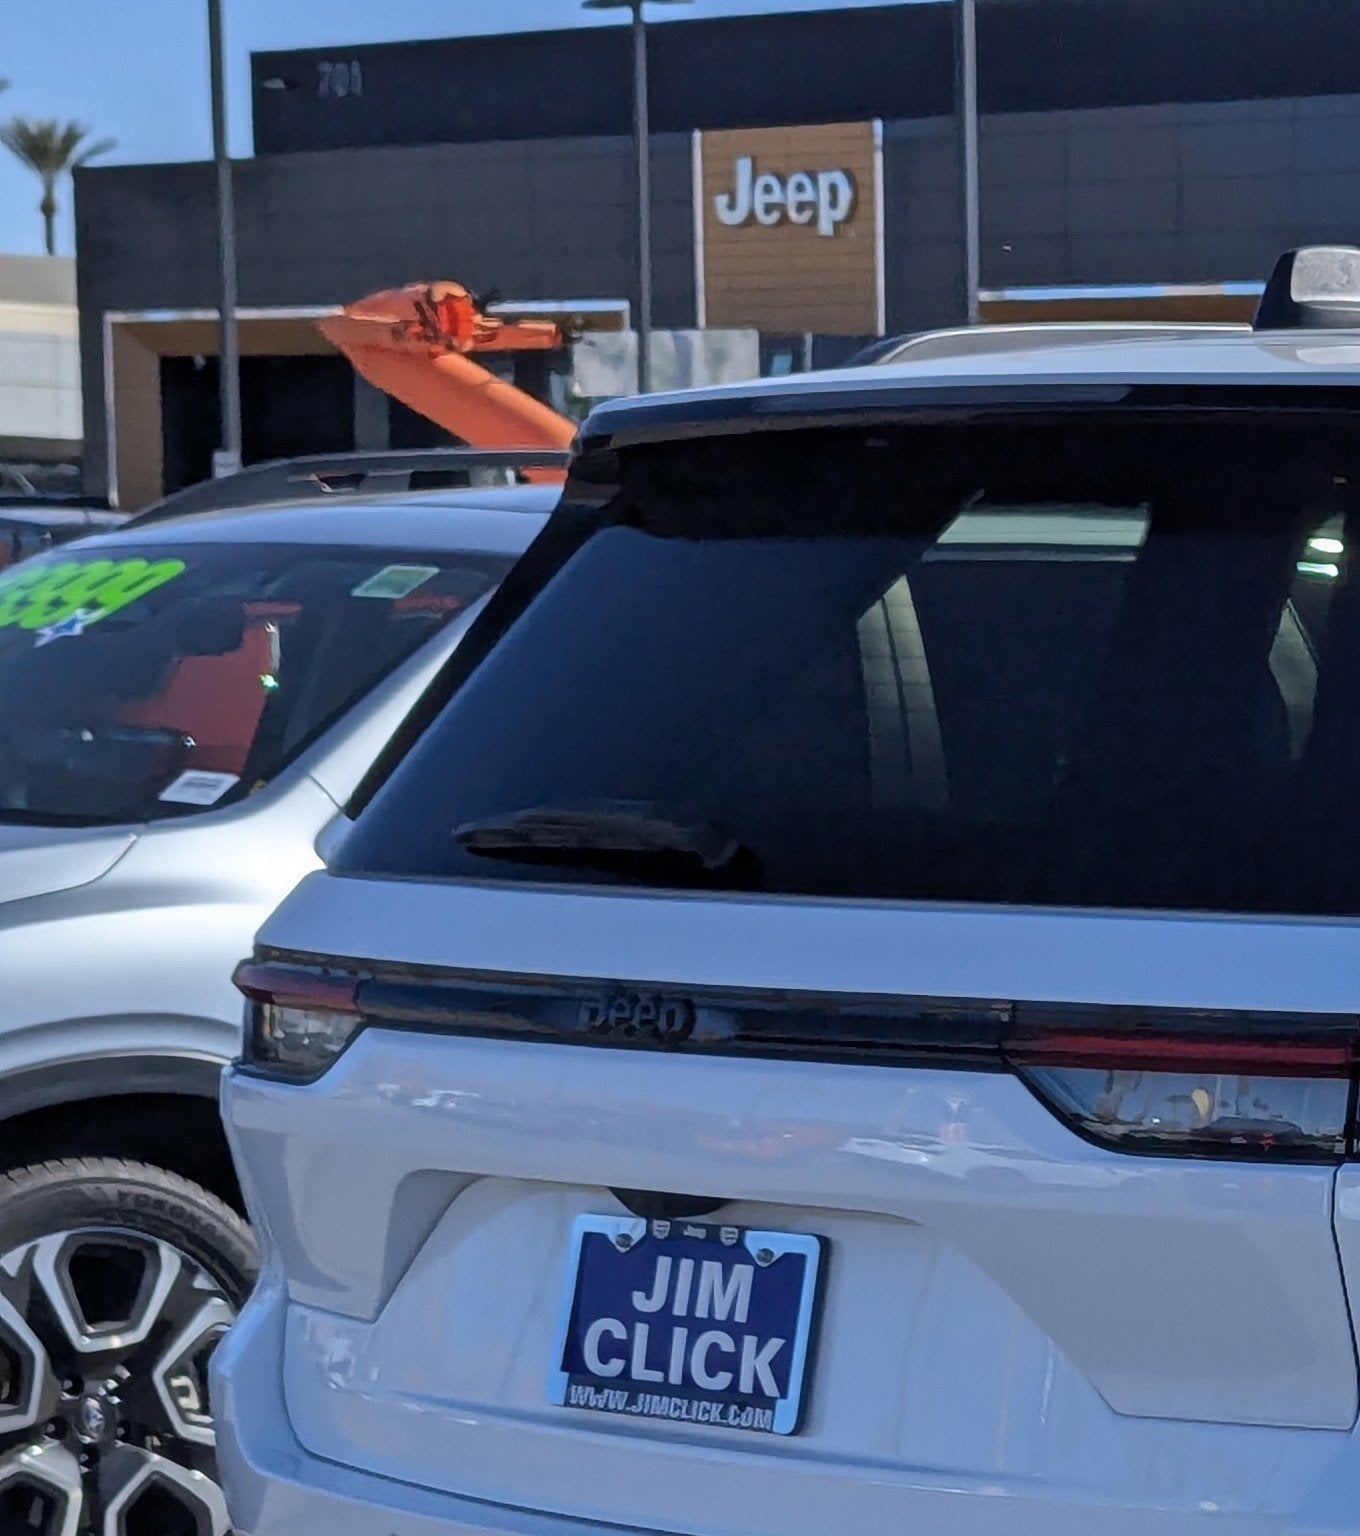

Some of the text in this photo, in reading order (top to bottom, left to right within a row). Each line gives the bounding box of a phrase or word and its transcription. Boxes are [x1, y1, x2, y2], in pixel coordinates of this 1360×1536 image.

[714, 157, 854, 237] Jeep
[632, 1255, 754, 1323] JIM
[583, 1317, 787, 1398] CLICK
